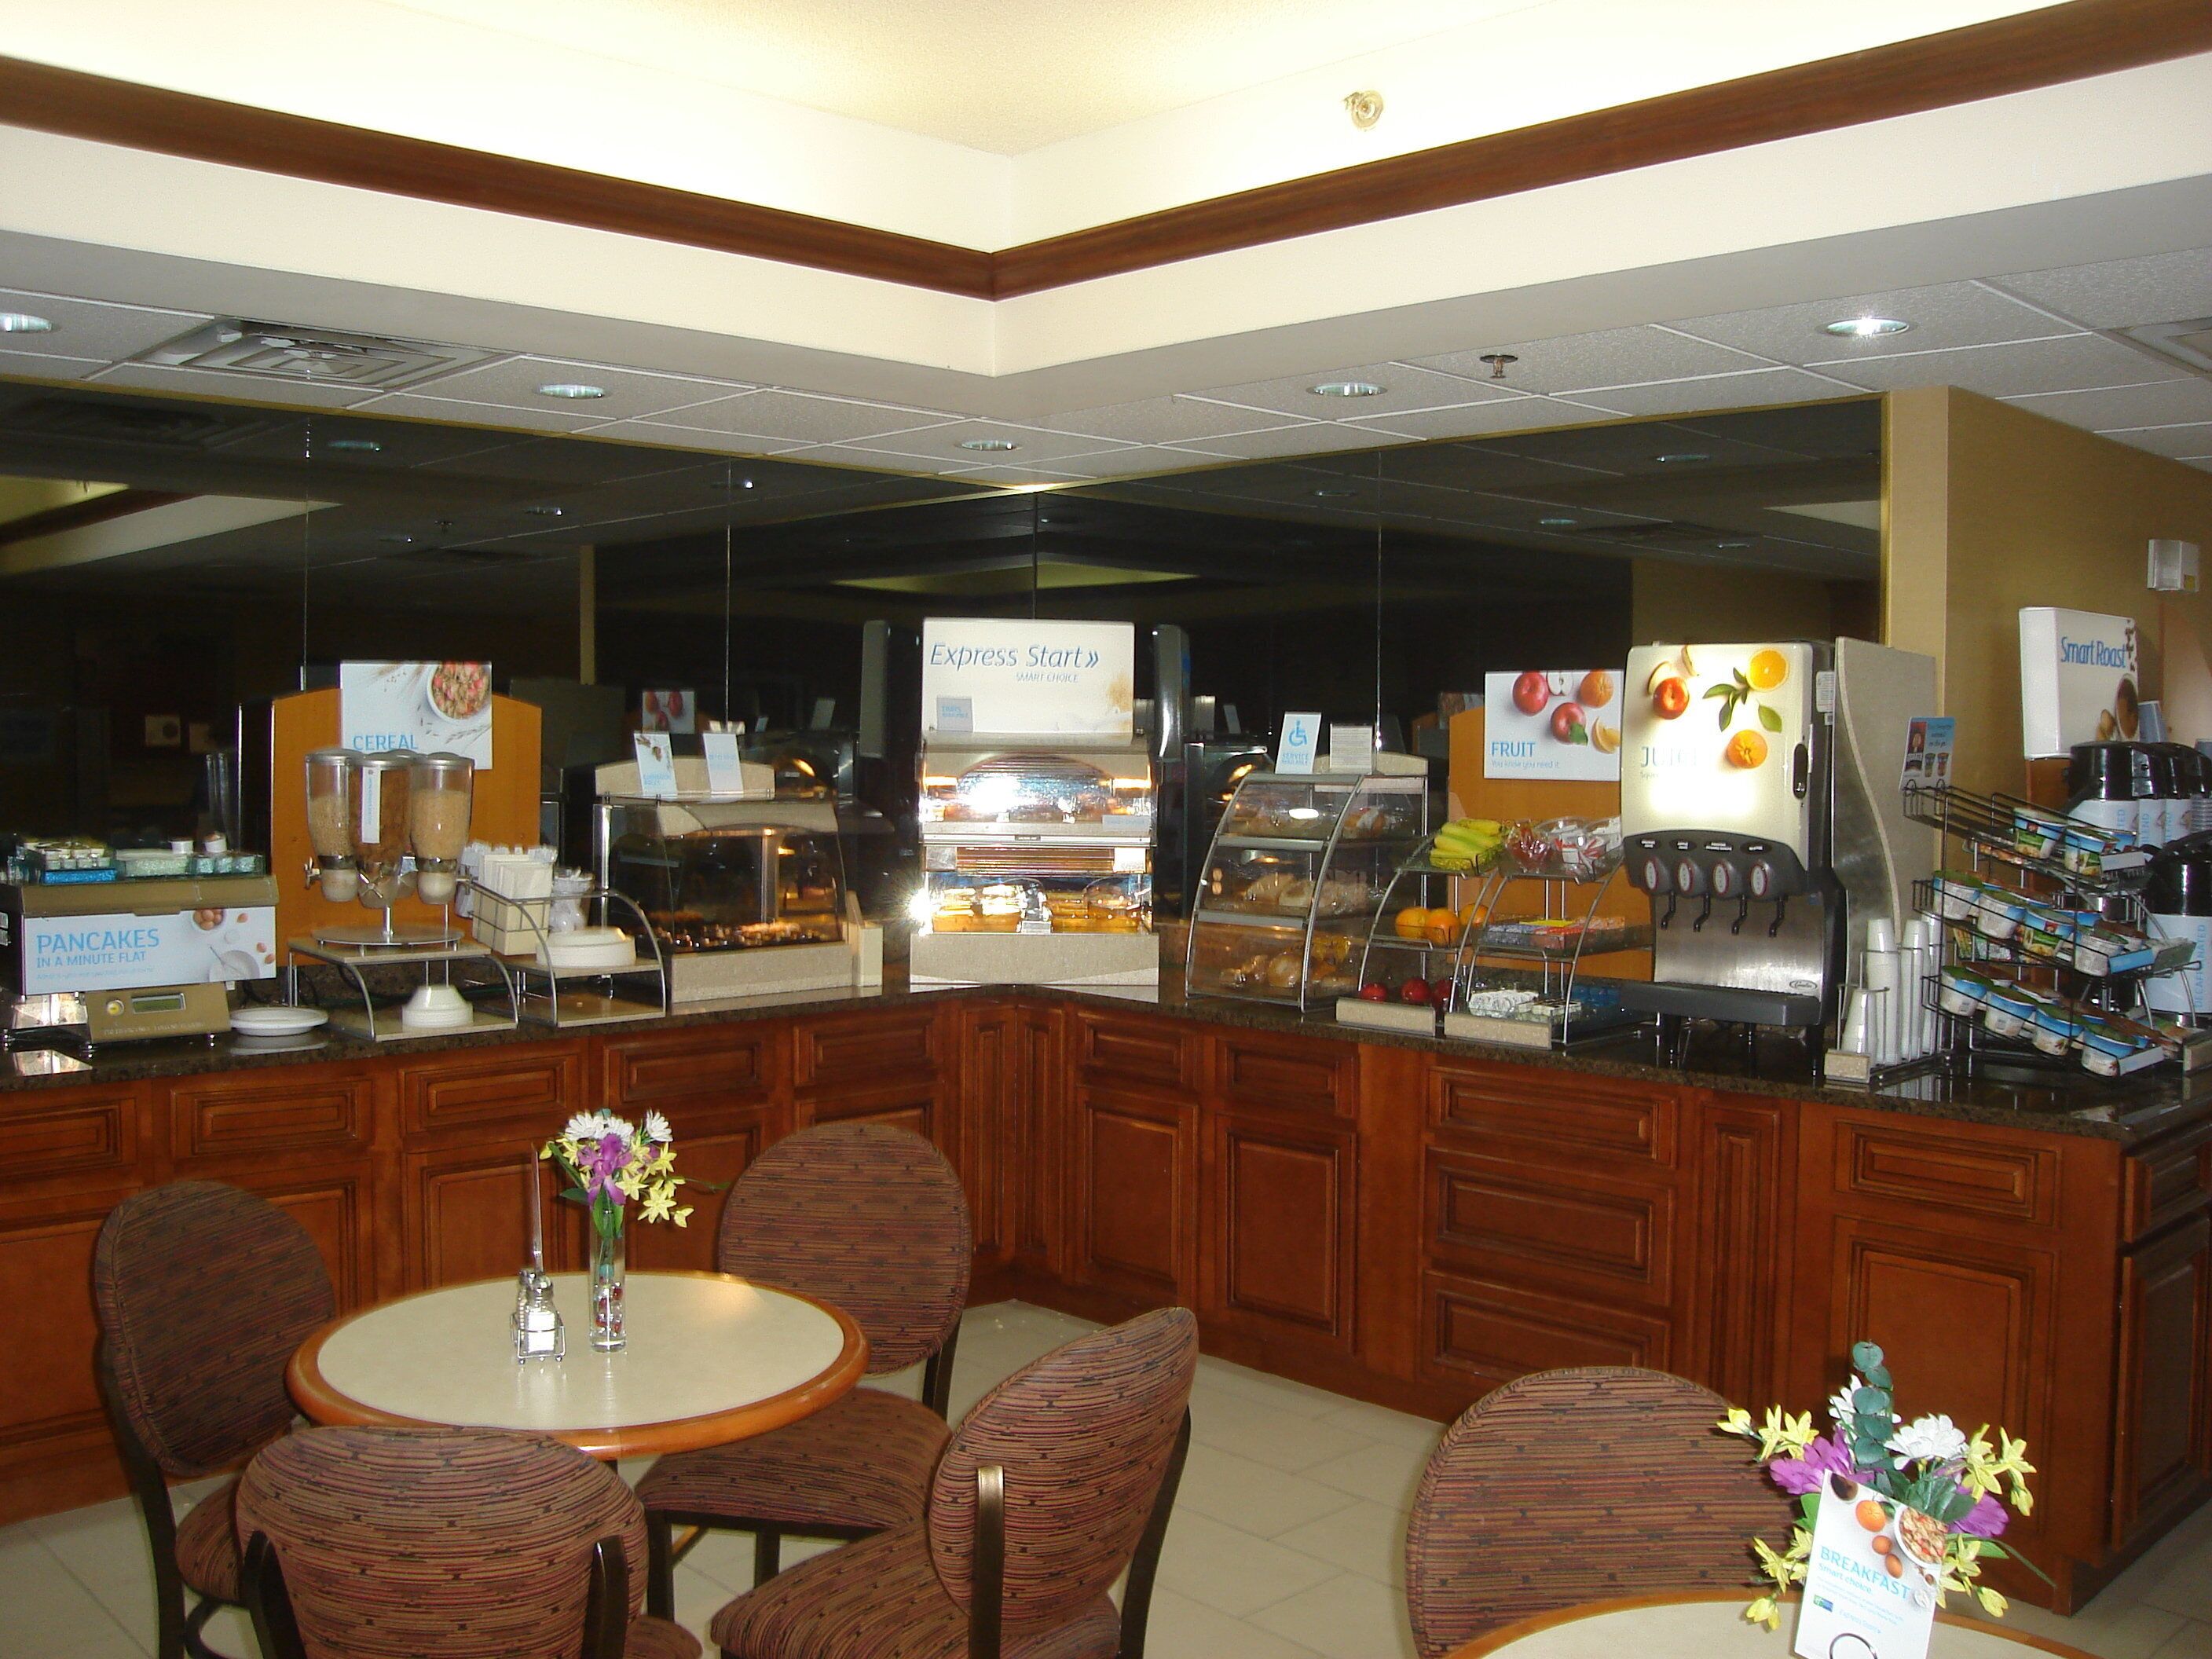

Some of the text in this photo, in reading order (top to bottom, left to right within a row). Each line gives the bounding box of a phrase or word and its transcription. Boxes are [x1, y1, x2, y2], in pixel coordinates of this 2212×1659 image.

[930, 643, 1082, 672] Express Start
[2061, 636, 2126, 668] Smart Roast
[1016, 673, 1079, 683] SMART CHOICE
[353, 734, 419, 751] CEREAL
[1491, 741, 1536, 757] FRUIT
[1640, 745, 1697, 767] JUIC
[36, 928, 160, 954] PANCAKES
[36, 950, 147, 969] IN A MINUTE FLAT
[1818, 1562, 1844, 1580] Smart
[1820, 1545, 1911, 1599] BREAKFAST
